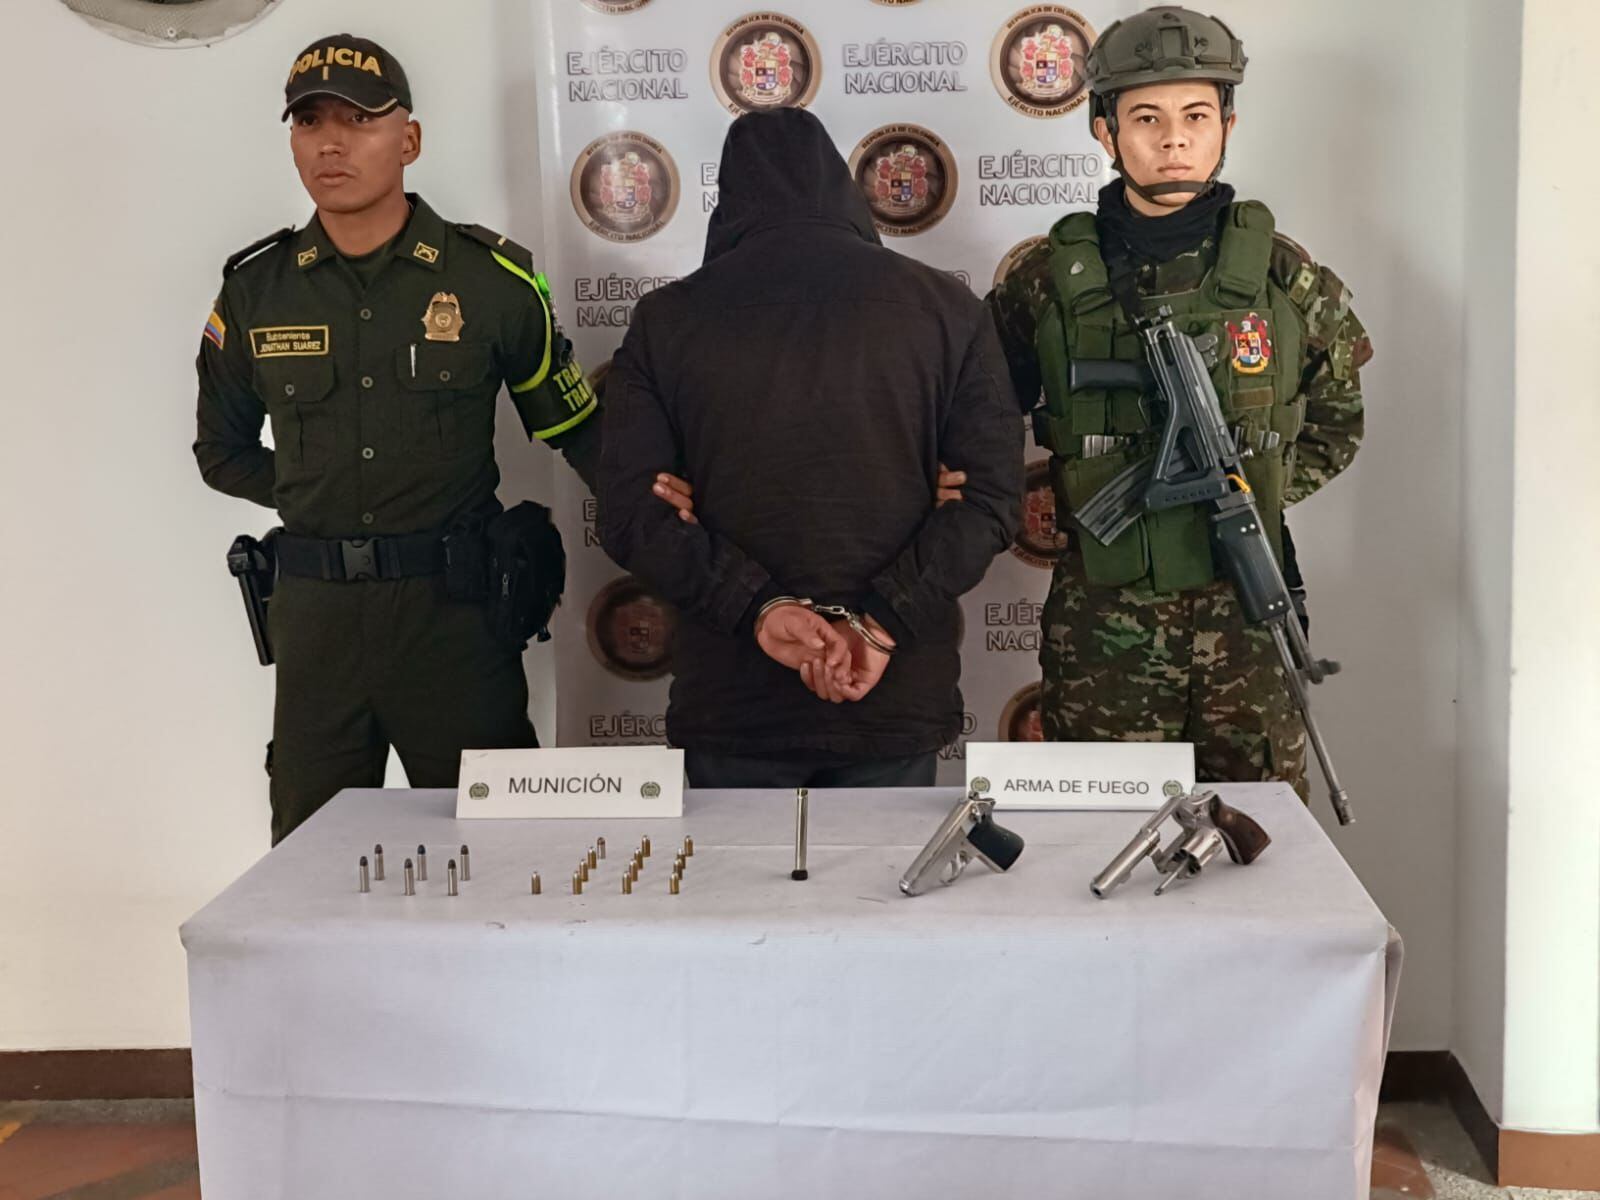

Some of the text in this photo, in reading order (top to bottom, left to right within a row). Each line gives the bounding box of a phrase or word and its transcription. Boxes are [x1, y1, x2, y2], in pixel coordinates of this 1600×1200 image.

[289, 46, 382, 83] POLICIA
[567, 45, 688, 75] EJÉRCITO
[842, 37, 968, 68] EJÉRCITO
[569, 78, 688, 102] NACIONAL
[844, 70, 968, 94] NACIONAL
[1045, 95, 1088, 117] NACIONAL
[978, 150, 1100, 179] EJÉRCITO
[980, 182, 1100, 206] NACIONAL
[575, 272, 679, 301] EJÉRC
[577, 305, 631, 327] NACI
[260, 341, 321, 353] JONATHAN SUAREZ
[985, 598, 1044, 625] EJÉR
[986, 630, 1042, 651] NACI
[590, 710, 667, 738] EJÉRC
[508, 773, 622, 794] MUNICIÓN
[1003, 778, 1150, 795] ARMA DE FUEGO
